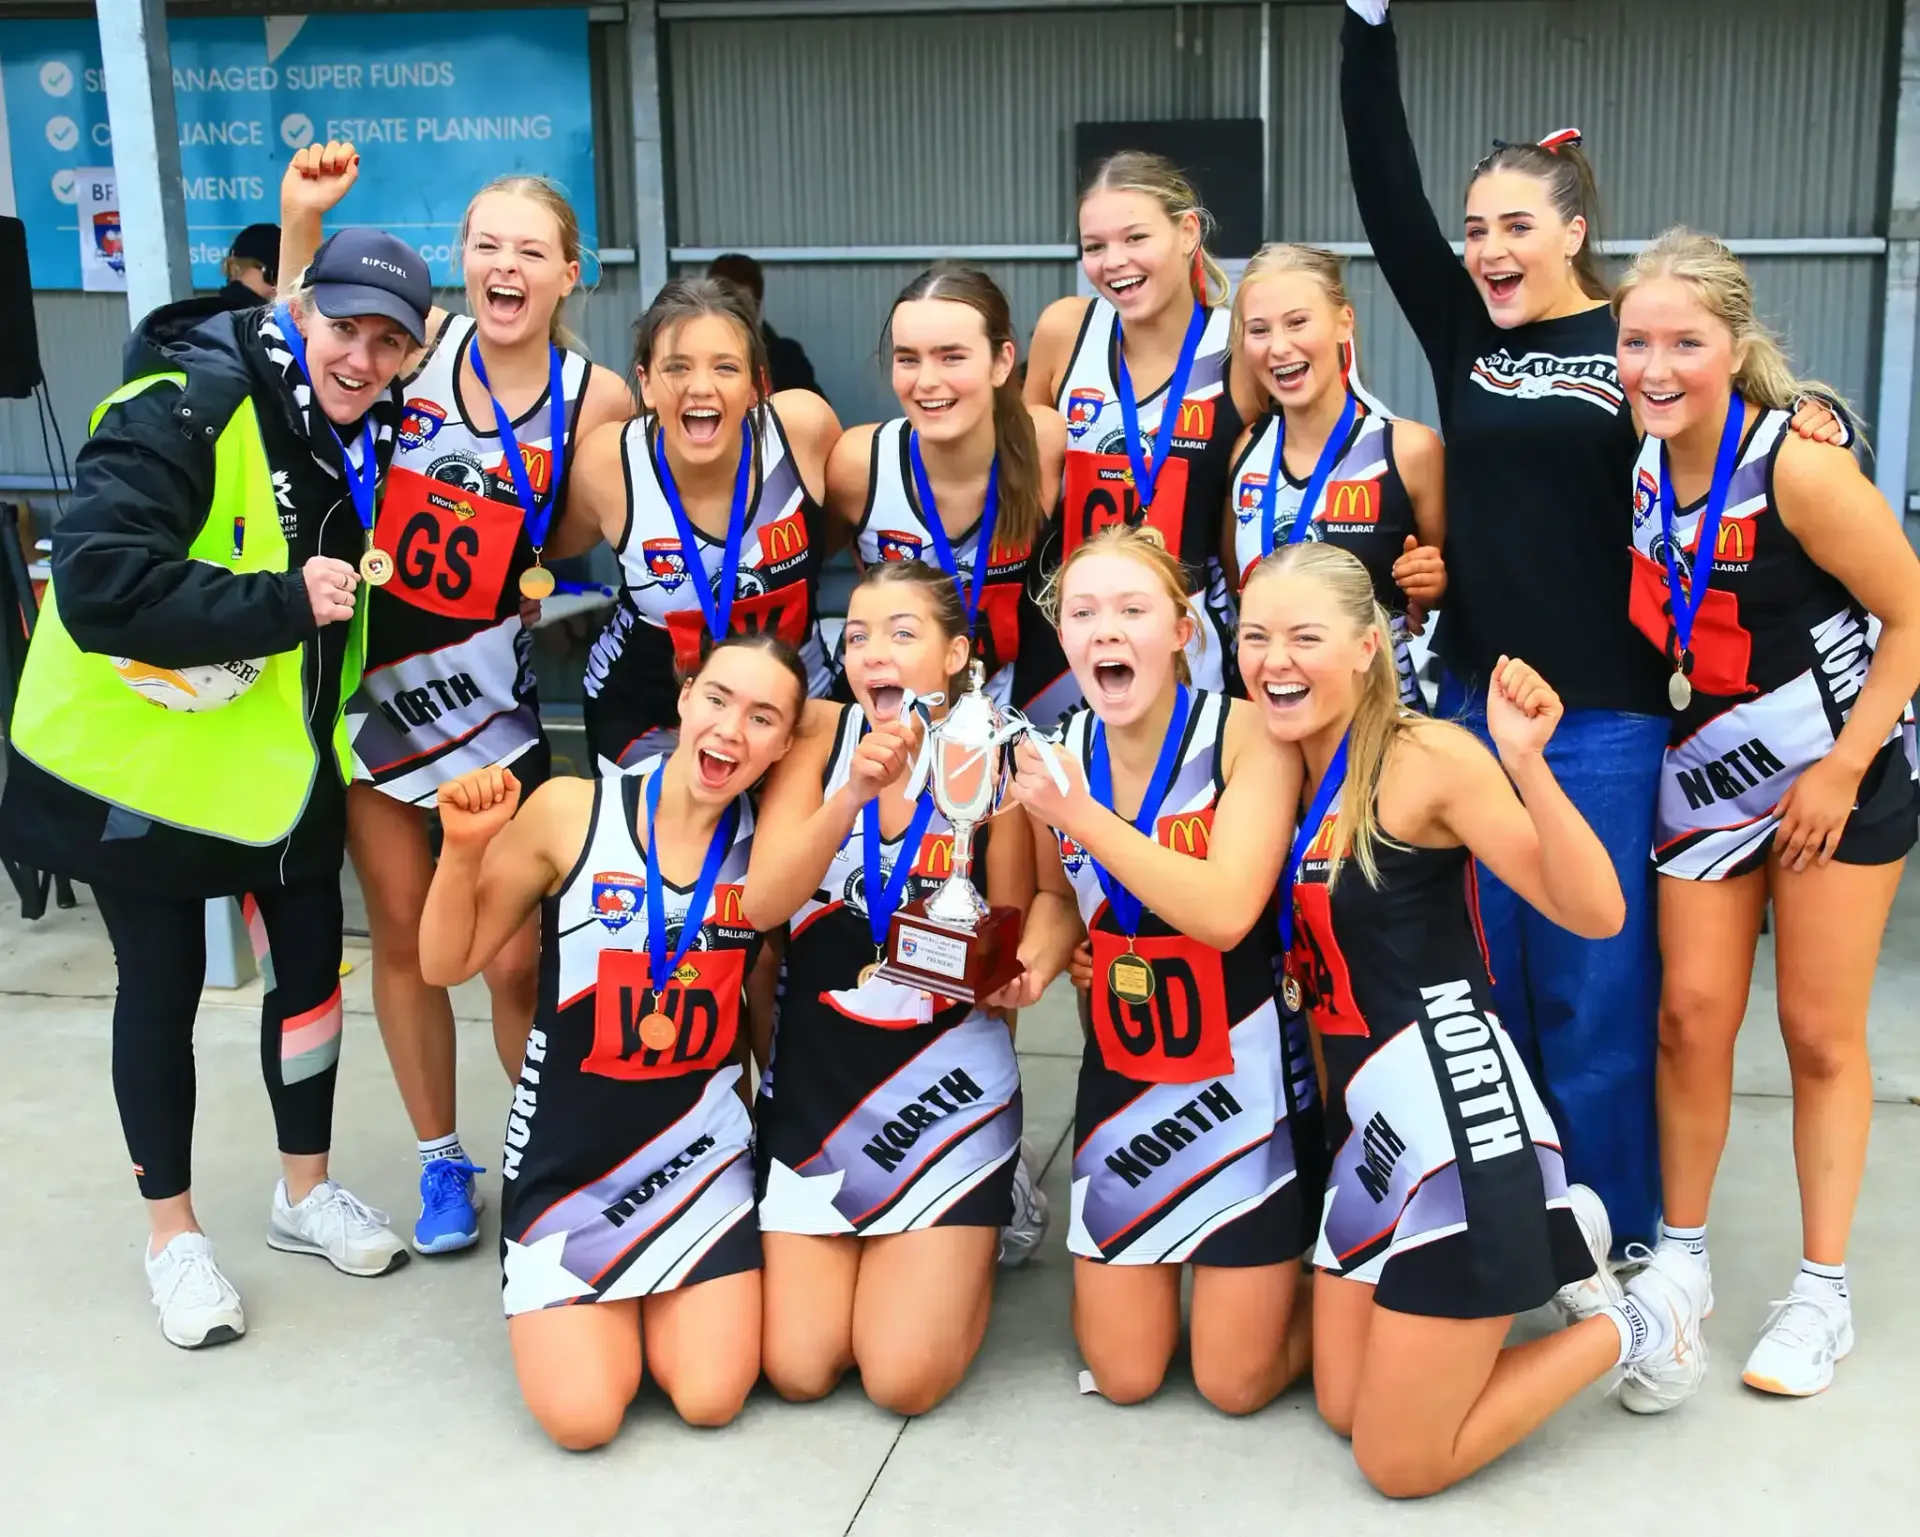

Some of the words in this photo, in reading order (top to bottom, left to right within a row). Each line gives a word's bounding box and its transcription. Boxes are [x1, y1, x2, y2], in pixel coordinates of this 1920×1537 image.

[172, 67, 278, 92] ANAGED
[286, 65, 362, 90] SUPER
[370, 62, 455, 88] FUNDS
[327, 119, 407, 143] ESTATE
[417, 115, 552, 142] PLANNING
[1534, 360, 1618, 383] BALLARA
[404, 431, 436, 452] BFNL
[1170, 439, 1207, 450] ALLARAT
[279, 514, 297, 525] RTH
[1327, 524, 1375, 533] BALLARAT
[397, 512, 479, 600] GS
[770, 550, 809, 575] BALLARAT
[987, 560, 1027, 576] BALLARAT
[1711, 563, 1749, 572] LARAT
[607, 910, 647, 922] BFNL
[717, 928, 755, 940] BALLARAT
[1108, 957, 1202, 1058] GD
[619, 986, 719, 1066] WD
[1418, 978, 1523, 1163] NORTH
[503, 1027, 548, 1181] NORTH
[861, 1067, 985, 1174] NORTH
[1105, 1081, 1243, 1189] NORTH
